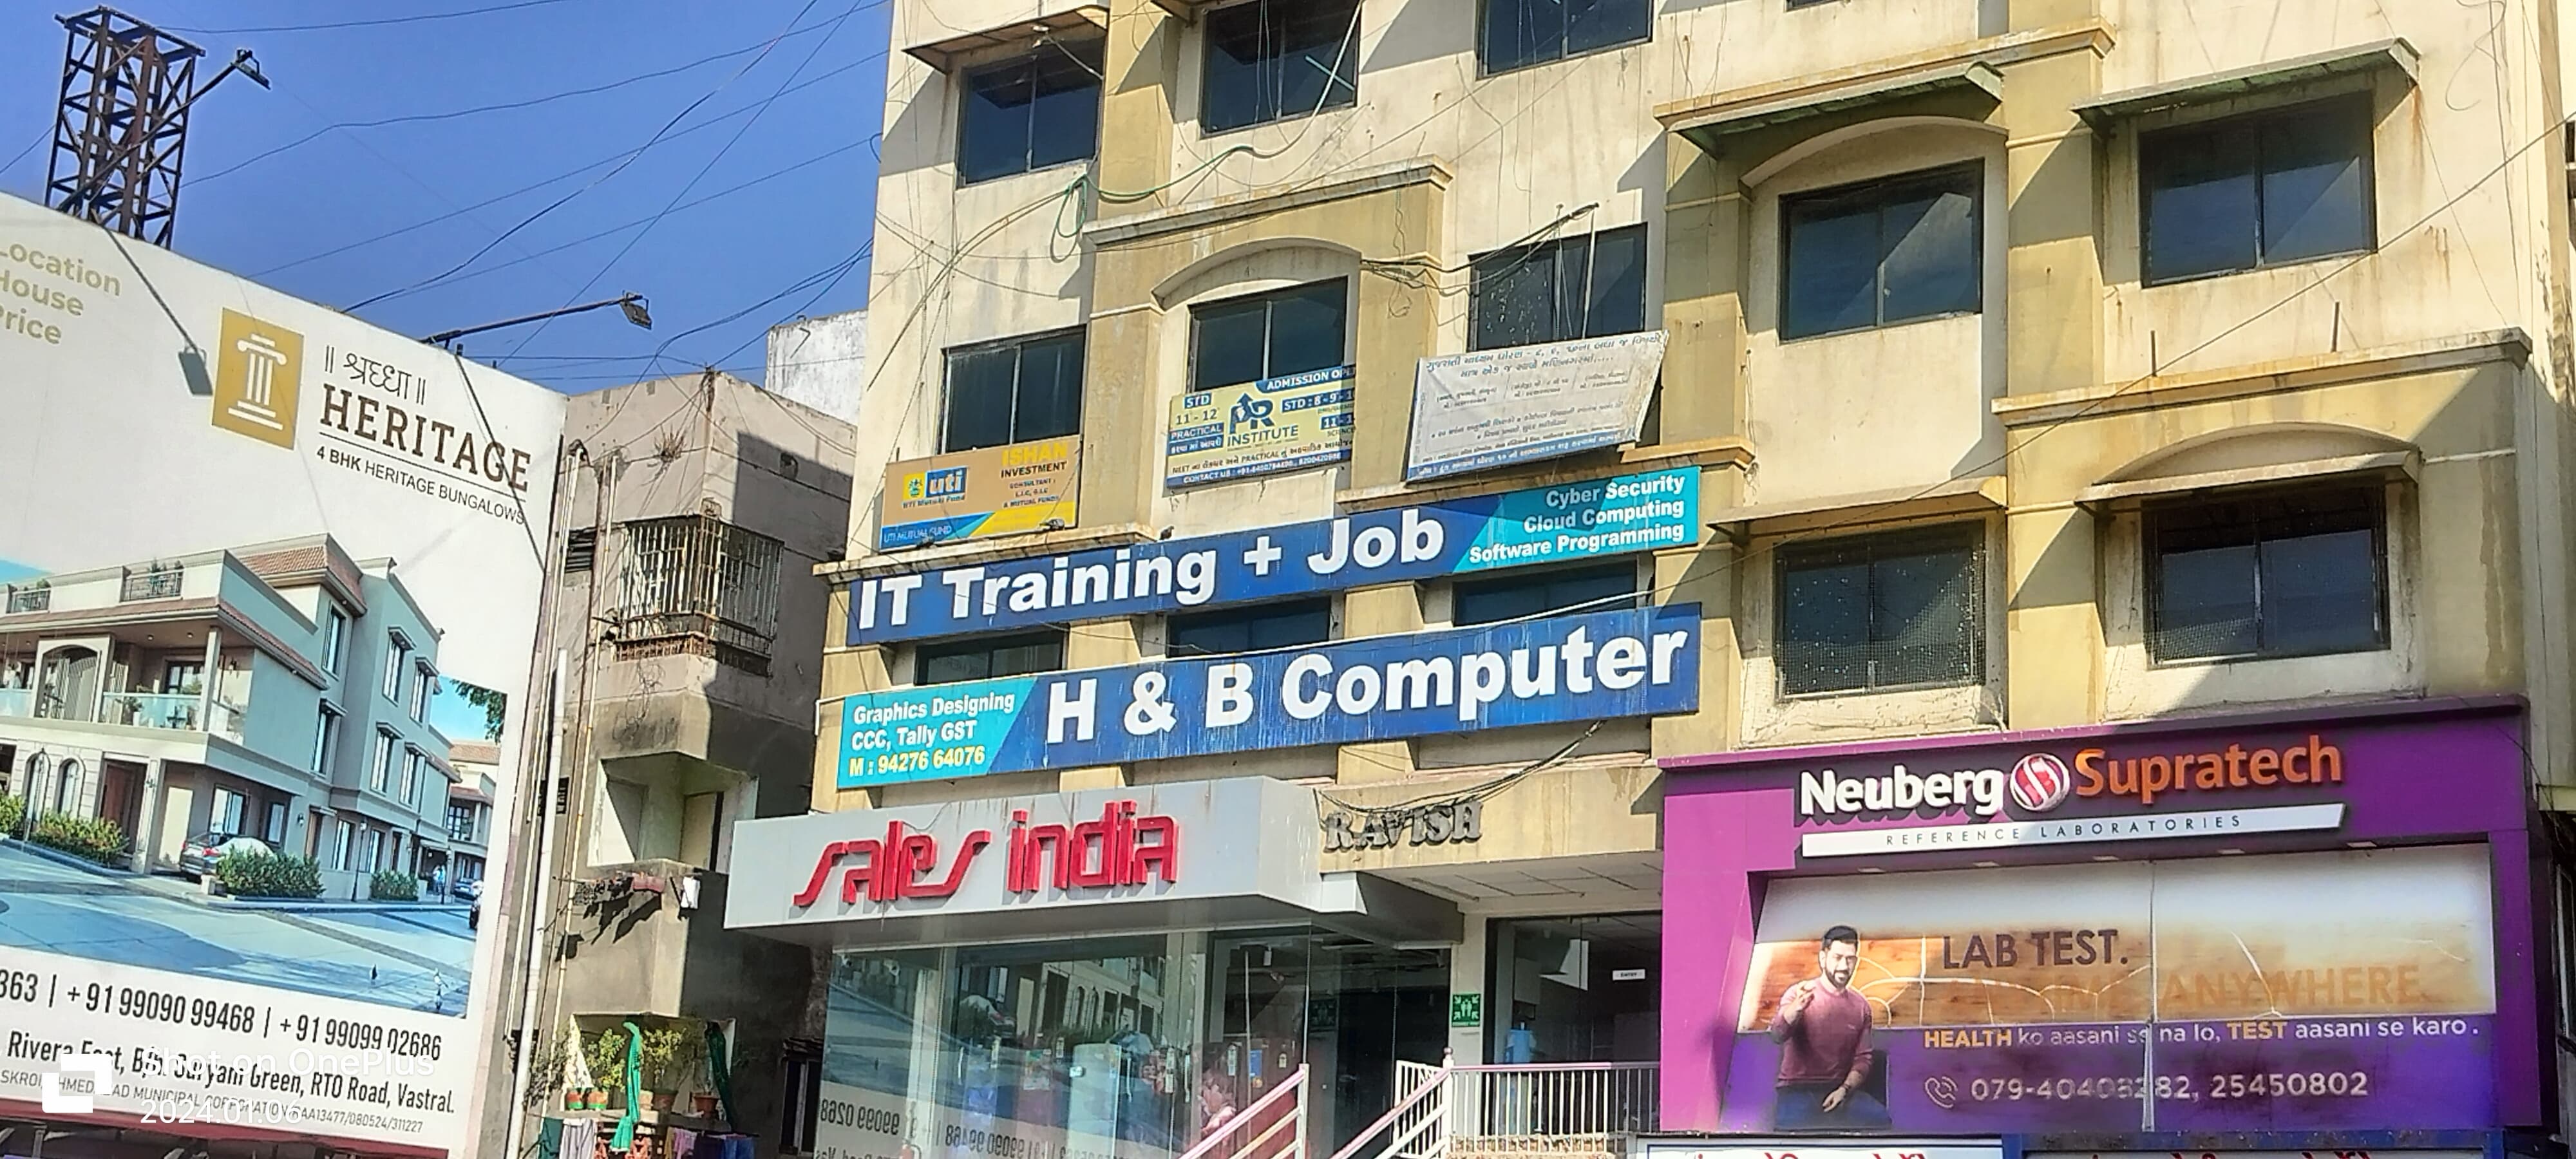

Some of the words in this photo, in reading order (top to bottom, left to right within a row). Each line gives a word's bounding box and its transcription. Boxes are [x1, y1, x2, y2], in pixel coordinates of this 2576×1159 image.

[0, 243, 120, 296] ocation
[0, 305, 62, 344] rice
[1266, 371, 1329, 391] ADMISSION
[1186, 395, 1210, 408] STD
[1283, 399, 1306, 411] STD
[320, 383, 531, 492] HERITAGE
[1171, 425, 1222, 440] PRACTICAL
[1227, 424, 1300, 448] INSTITUTE
[1001, 442, 1068, 467] ISHAN
[1001, 461, 1067, 478] INVESTMENT
[1172, 465, 1189, 474] NEET
[1241, 451, 1279, 464] PRACTICAL
[317, 446, 325, 460] 4
[329, 449, 361, 471] BHK
[365, 460, 435, 495] HERITAGE
[439, 484, 526, 525] BUNGALOWS
[929, 469, 963, 495] uti
[1183, 472, 1219, 484] CONTACT
[1546, 486, 1600, 509] Cyber
[1605, 473, 1685, 501] Security
[1524, 513, 1577, 534] Cloud
[1582, 498, 1685, 528] Computing
[1469, 541, 1551, 565] Software
[1557, 522, 1685, 554] Programming
[858, 573, 923, 630] IT
[942, 545, 1218, 619] Training
[1244, 536, 1283, 576] +
[1307, 509, 1445, 574] Job
[1046, 677, 1098, 744] H
[1124, 670, 1177, 736] &
[1204, 662, 1255, 729] B
[1282, 625, 1688, 722] Computer
[853, 702, 927, 726] Graphics
[931, 690, 1016, 717] Designing
[851, 729, 893, 752] CCC,
[896, 724, 938, 749] Tally
[940, 719, 978, 740] GST
[849, 758, 865, 777] M
[877, 749, 929, 775] 94276
[933, 744, 986, 771] 64076
[1801, 762, 2005, 816] Neuberg
[2074, 733, 2343, 806] Supratech
[1323, 799, 1483, 853] RAVISH
[1886, 827, 2021, 845] REFERENCE
[2040, 815, 2241, 838] LABORATORIES
[793, 820, 992, 907] sales
[1005, 798, 1180, 893] india
[1942, 933, 2019, 970] LAB
[2031, 928, 2129, 967] TEST.
[118, 987, 186, 1024] 99090
[190, 997, 255, 1033] 99468
[325, 1018, 383, 1051] 99099
[387, 1028, 442, 1061] 02686
[1924, 1028, 2012, 1048] HEALTH
[2018, 1027, 2043, 1046] ko
[2050, 1025, 2120, 1046] aasani
[2159, 1027, 2186, 1043] na
[2227, 1020, 2289, 1041] TEST
[2295, 1019, 2371, 1040] aasani
[2377, 1019, 2405, 1037] se
[2412, 1016, 2467, 1037] karo
[250, 1062, 305, 1098] Green,
[310, 1071, 343, 1098] RTO
[346, 1077, 392, 1109] Road,
[397, 1082, 455, 1114] Vastral.
[2210, 1072, 2369, 1098] 25450802
